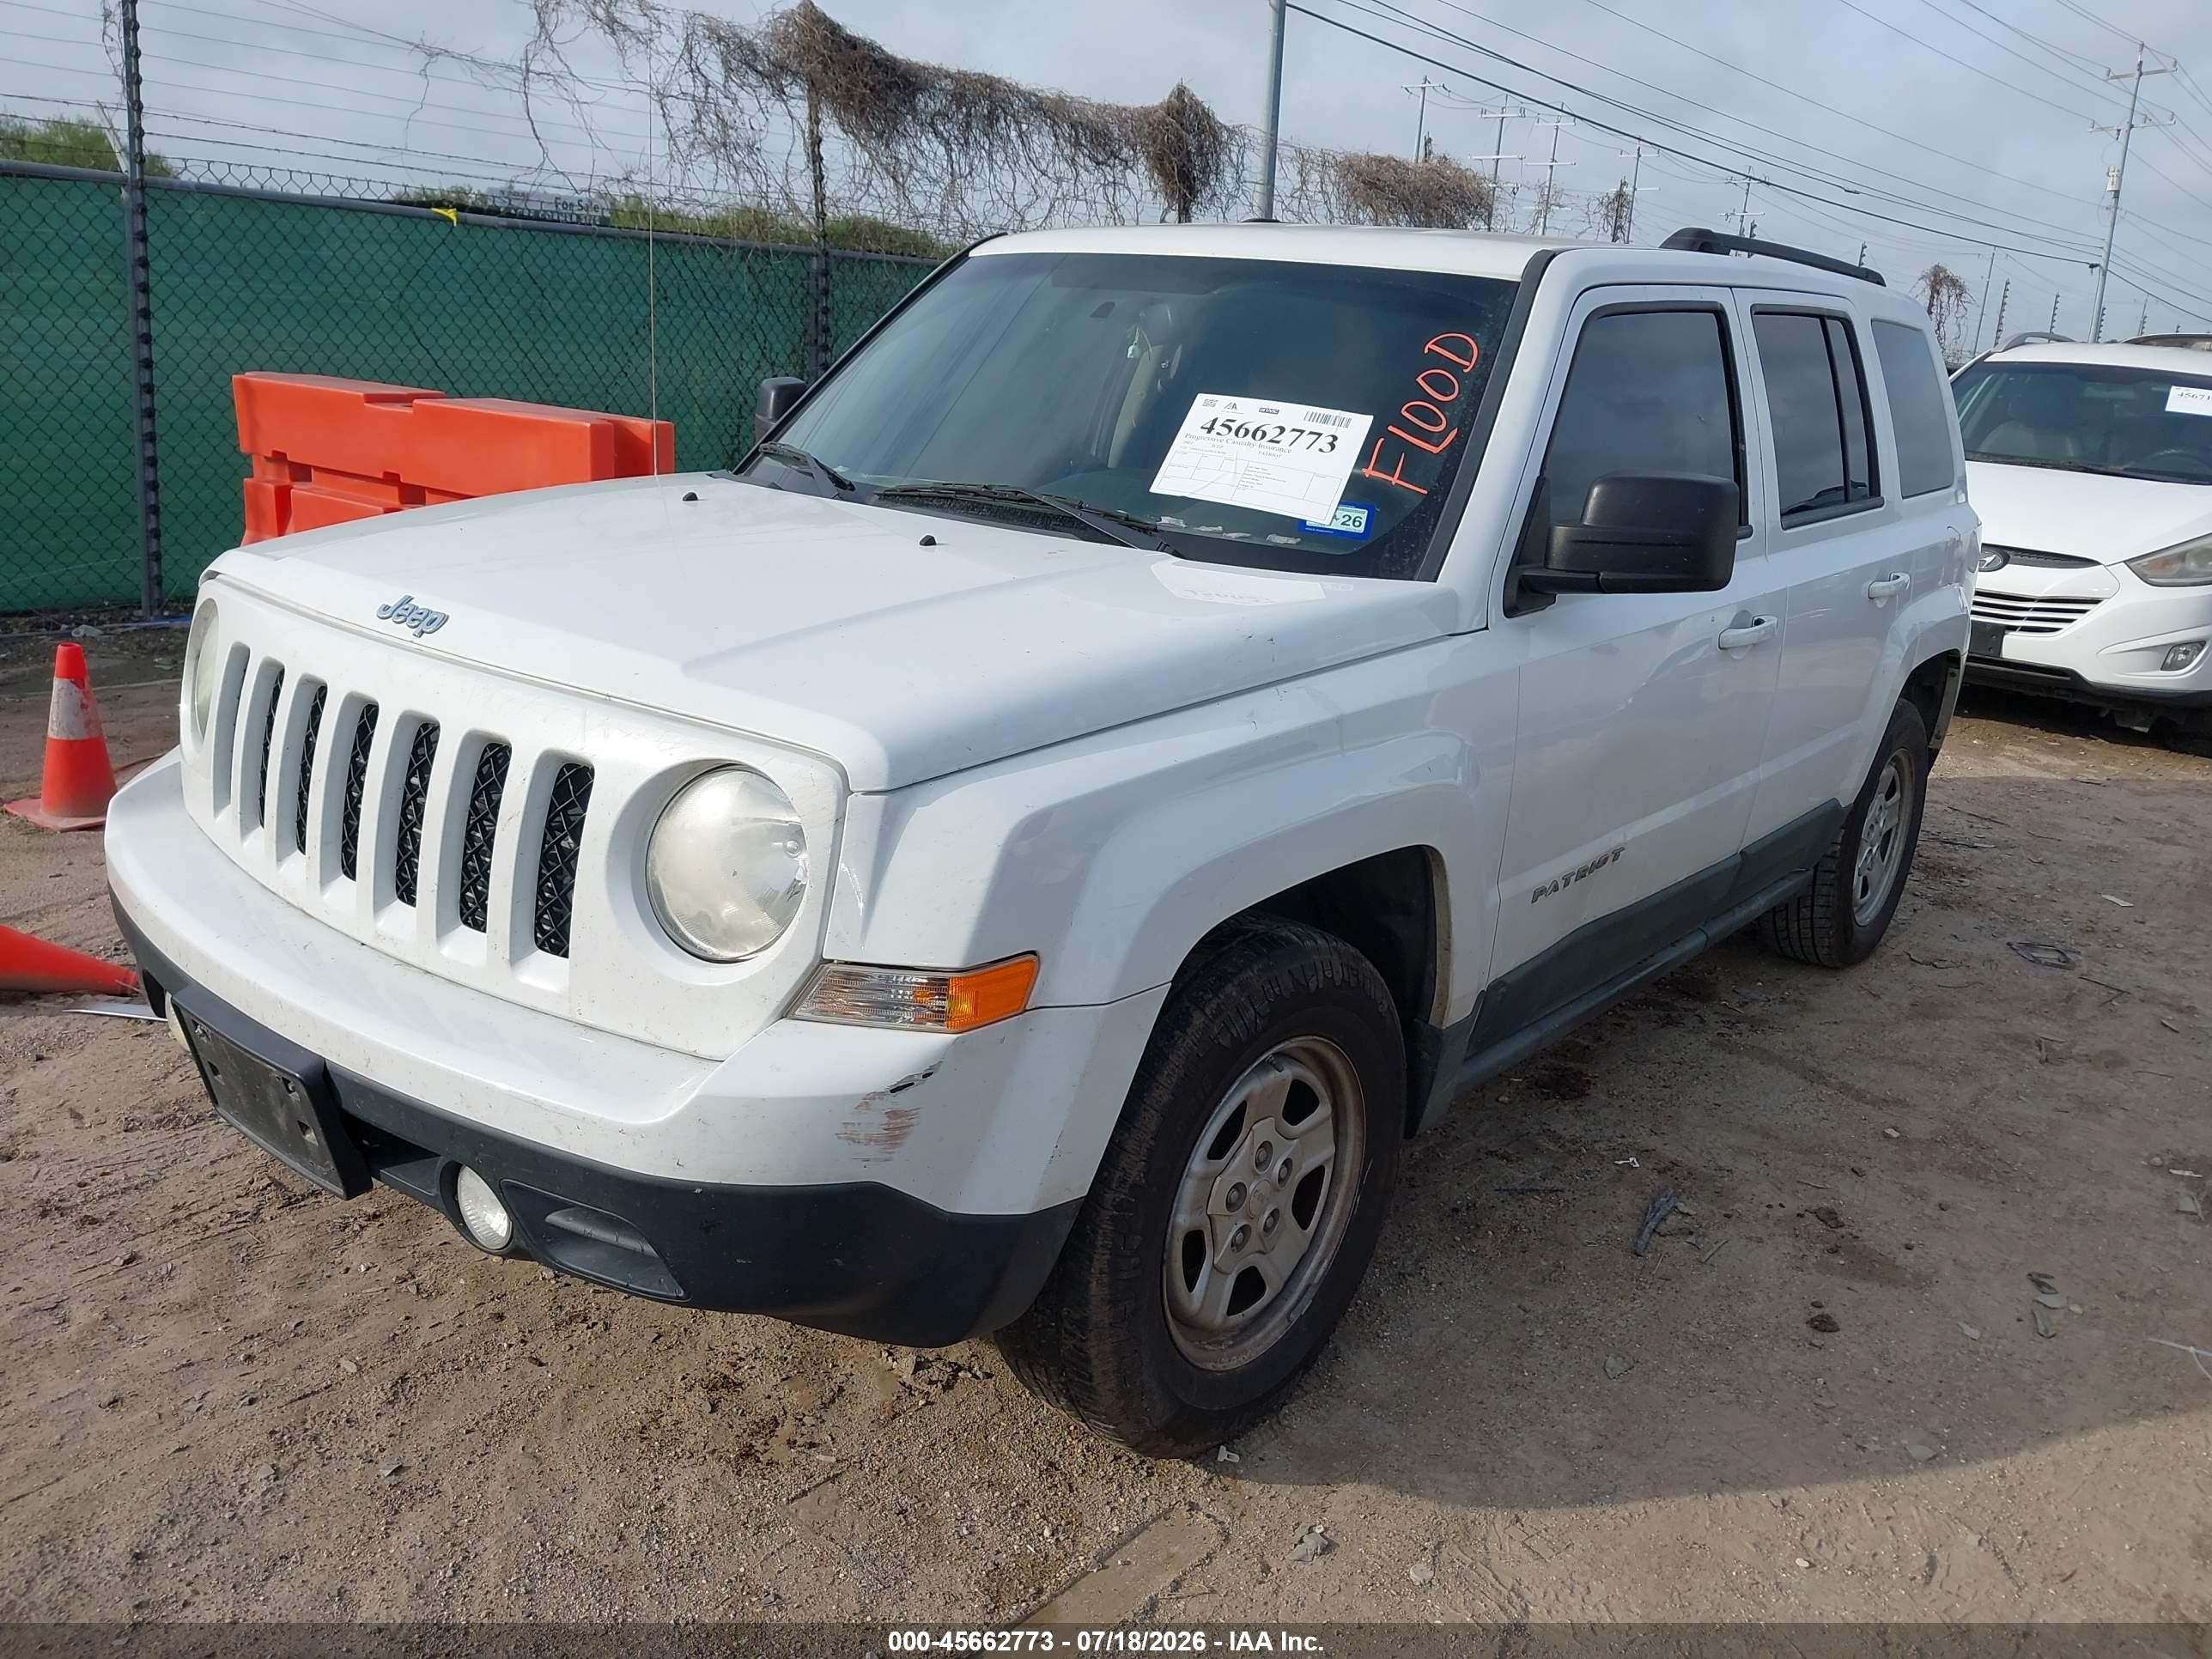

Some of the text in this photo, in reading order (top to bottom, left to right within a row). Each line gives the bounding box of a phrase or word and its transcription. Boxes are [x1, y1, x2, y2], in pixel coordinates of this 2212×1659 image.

[1360, 331, 1480, 495] FLOOD
[1184, 433, 1224, 443] Progressive
[1225, 437, 1257, 447] Casualty
[1258, 442, 1292, 454] Insurance
[1200, 416, 1339, 453] 45662773
[1340, 514, 1364, 528] 26
[376, 594, 450, 638] Jeep
[1531, 846, 1626, 904] PATRIOT
